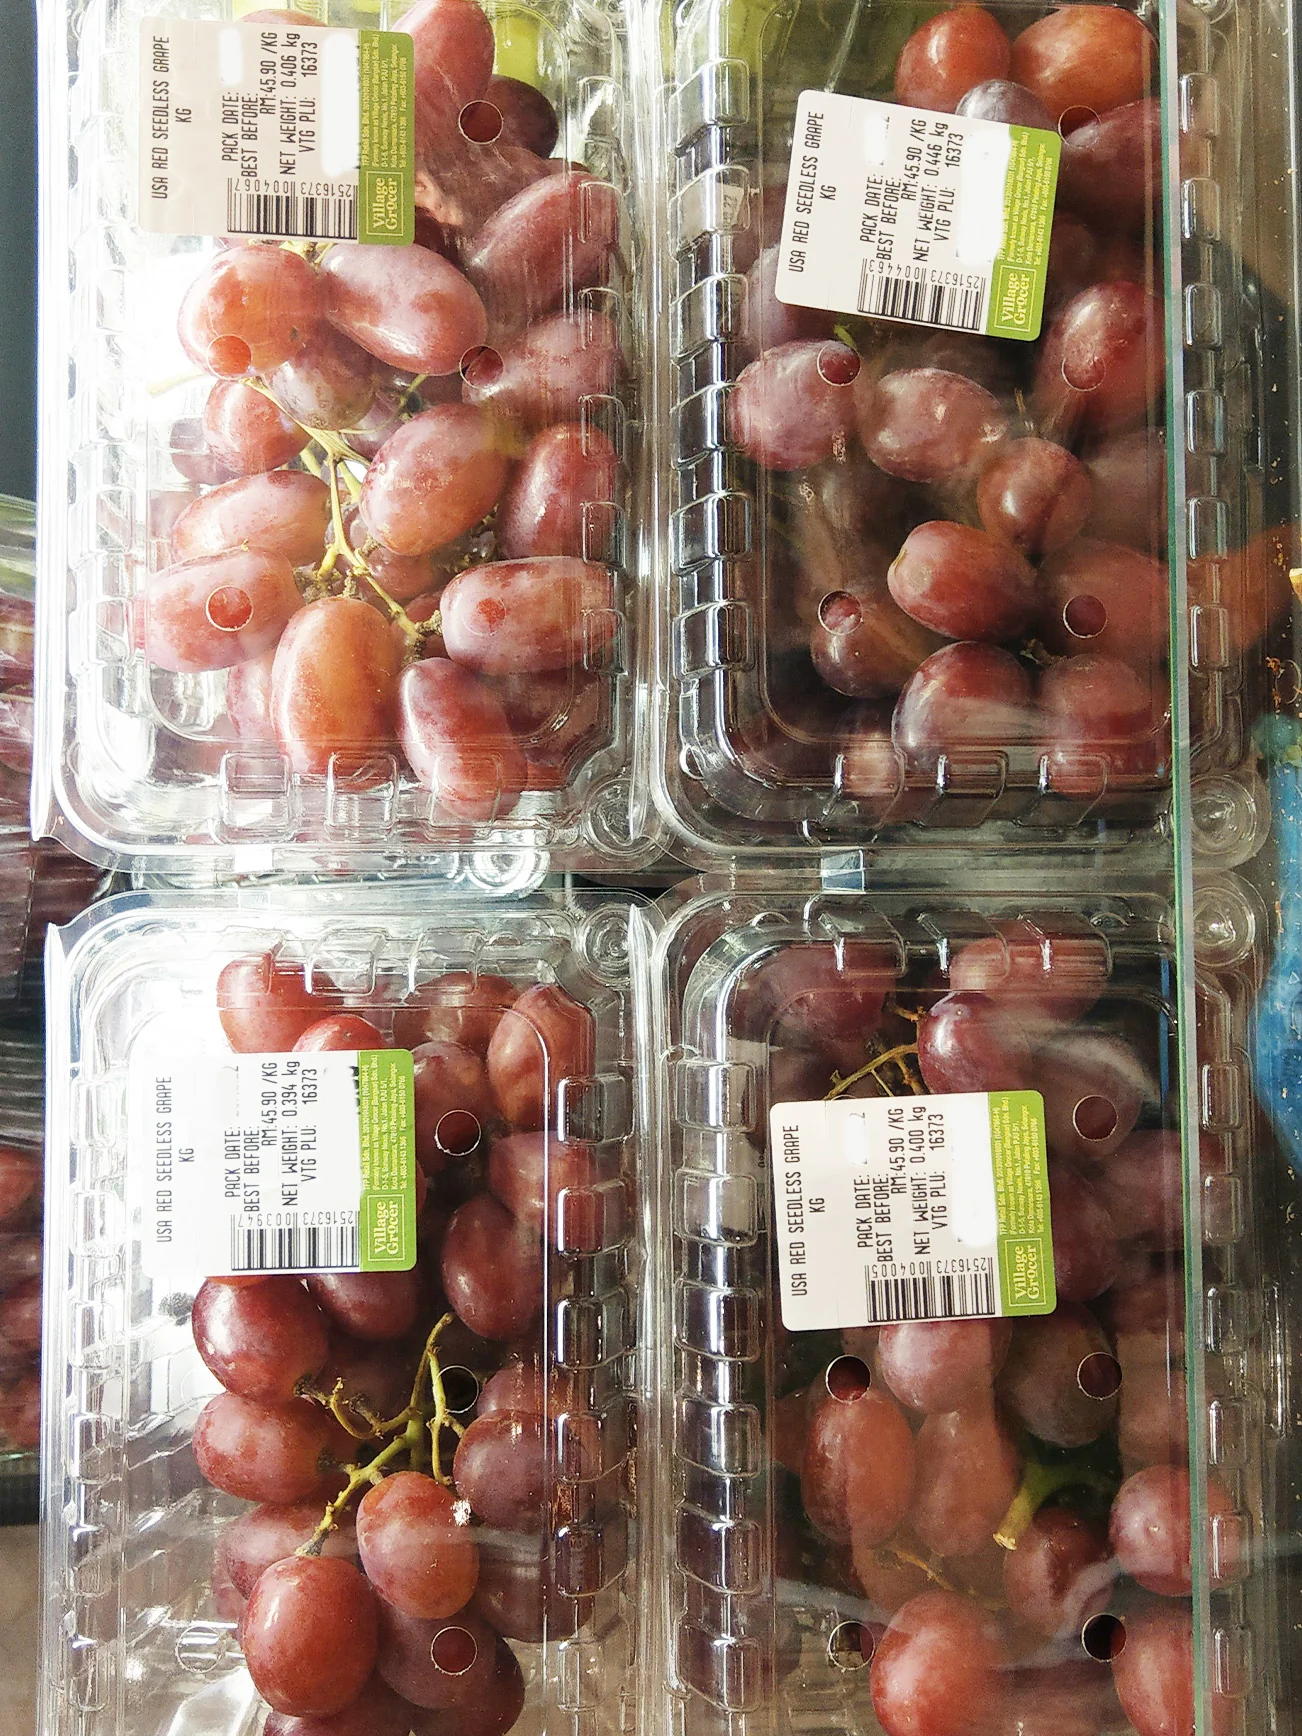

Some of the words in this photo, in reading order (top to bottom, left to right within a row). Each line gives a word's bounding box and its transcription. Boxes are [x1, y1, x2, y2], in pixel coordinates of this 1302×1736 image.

[153, 36, 169, 72] GRAPE
[261, 32, 277, 53] /KG
[281, 33, 300, 48] kg
[281, 55, 297, 87] 0.406
[301, 41, 317, 77] 16373
[260, 60, 276, 114] RM:45.90
[153, 80, 168, 139] SEEDLESS
[176, 108, 192, 123] KG
[223, 92, 239, 124] DATE:
[242, 93, 258, 140] BEFORE:
[280, 96, 297, 143] WEIGHT:
[300, 97, 316, 122] PLU:
[299, 130, 316, 153] VTG
[805, 112, 824, 149] GRAPE
[909, 119, 926, 141] /KG
[929, 122, 949, 138] kg
[152, 147, 168, 169] RED
[222, 132, 238, 161] PACK
[924, 142, 943, 177] 0.446
[945, 133, 964, 167] 16373
[241, 148, 257, 177] BEST
[280, 152, 296, 175] NET
[901, 146, 923, 201] RM:45.90
[152, 177, 167, 199] USA
[235, 178, 289, 192] 004067
[301, 181, 351, 197] 2516373
[796, 156, 819, 214] SEEDLESS
[820, 184, 837, 200] KG
[864, 173, 884, 206] DATE:
[372, 178, 385, 228] Village
[385, 178, 397, 229] Grocer
[881, 176, 901, 225] BEFORE:
[918, 183, 938, 232] WEIGHT:
[938, 188, 956, 213] PLU:
[792, 220, 809, 243] RED
[860, 212, 878, 243] PACK
[933, 218, 950, 242] VTG
[789, 249, 806, 272] USA
[876, 231, 894, 261] BEST
[913, 239, 931, 261] NET
[868, 259, 920, 280] 004463
[931, 270, 979, 288] 2516373
[1001, 272, 1018, 321] Village
[1014, 274, 1030, 325] Grocer
[262, 1062, 277, 1085] /KG
[282, 1061, 300, 1076] kg
[156, 1076, 171, 1114] GRAPE
[282, 1084, 297, 1117] 0.394
[302, 1069, 317, 1104] 16373
[262, 1091, 277, 1146] RM:45.90
[888, 1108, 904, 1131] /KG
[908, 1107, 926, 1121] kg
[225, 1126, 241, 1160] DATE:
[301, 1125, 317, 1151] PLU:
[783, 1125, 801, 1163] GRAPE
[908, 1129, 925, 1164] 0.400
[929, 1113, 945, 1151] 16373
[157, 1121, 172, 1182] SEEDLESS
[179, 1147, 194, 1163] KG
[244, 1126, 260, 1174] BEFORE:
[282, 1125, 298, 1174] WEIGHT:
[301, 1158, 317, 1182] VTG
[889, 1137, 907, 1194] RM:45.90
[225, 1168, 240, 1197] PACK
[244, 1182, 260, 1212] BEST
[282, 1182, 297, 1205] NET
[854, 1175, 870, 1209] DATE:
[911, 1172, 928, 1222] WEIGHT:
[930, 1171, 946, 1196] PLU:
[156, 1189, 172, 1212] RED
[785, 1172, 804, 1233] SEEDLESS
[810, 1197, 825, 1214] KG
[873, 1173, 892, 1223] BEFORE:
[156, 1220, 172, 1242] USA
[238, 1213, 291, 1227] 003947
[303, 1211, 353, 1226] 2516373
[374, 1201, 386, 1253] Village
[386, 1201, 399, 1254] Grocer
[857, 1217, 873, 1248] PACK
[931, 1205, 948, 1231] VTG
[789, 1241, 806, 1265] RED
[877, 1233, 893, 1263] BEST
[914, 1231, 930, 1255] NET
[872, 1262, 925, 1277] 004005
[937, 1258, 986, 1273] 2516373
[1015, 1246, 1028, 1299] Village
[1025, 1245, 1040, 1299] Grocer
[791, 1274, 807, 1296] USA
